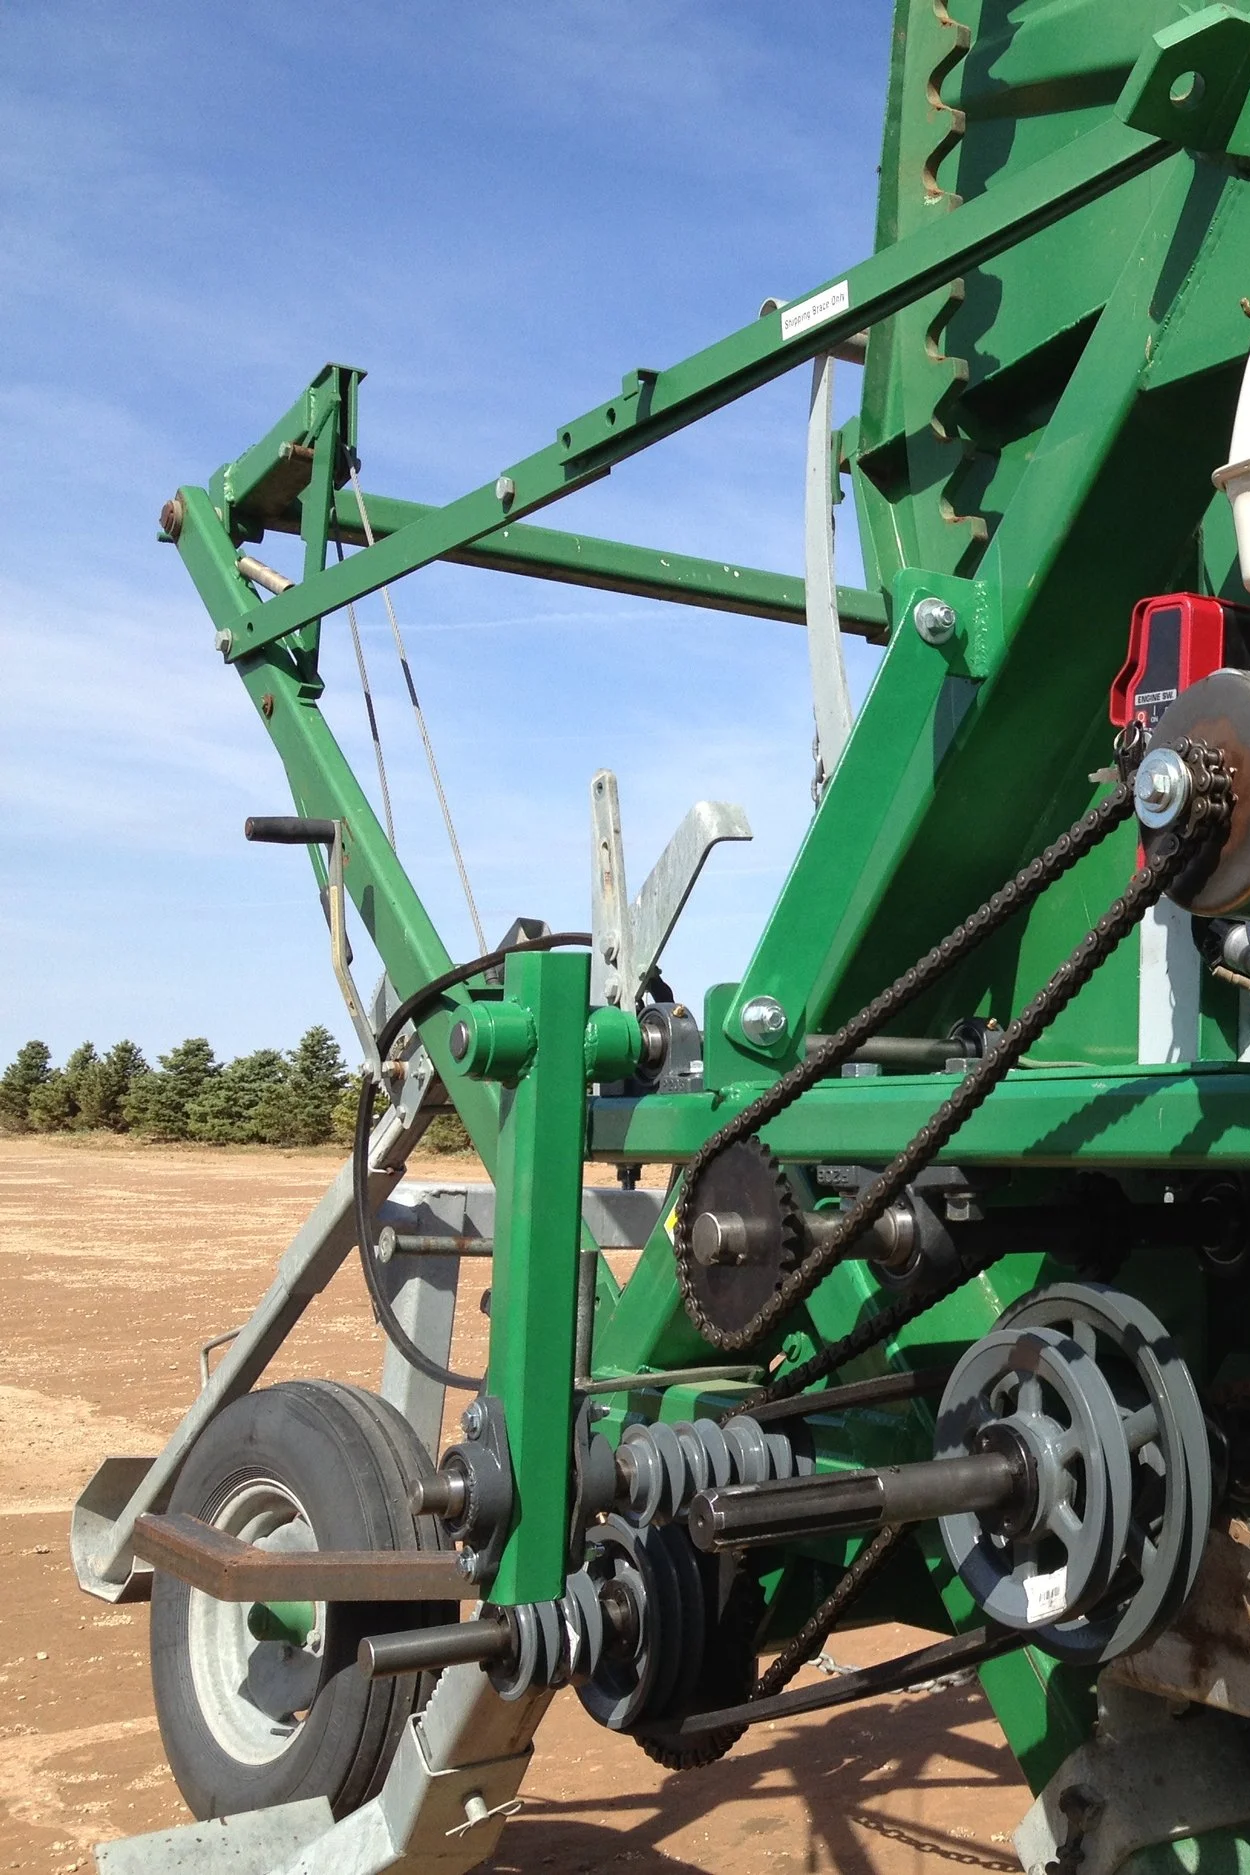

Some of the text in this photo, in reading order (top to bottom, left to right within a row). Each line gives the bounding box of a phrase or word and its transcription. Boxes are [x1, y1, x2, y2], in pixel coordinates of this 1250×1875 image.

[784, 293, 845, 330] Shipping Brace Only
[1138, 692, 1160, 704] ENGINE
